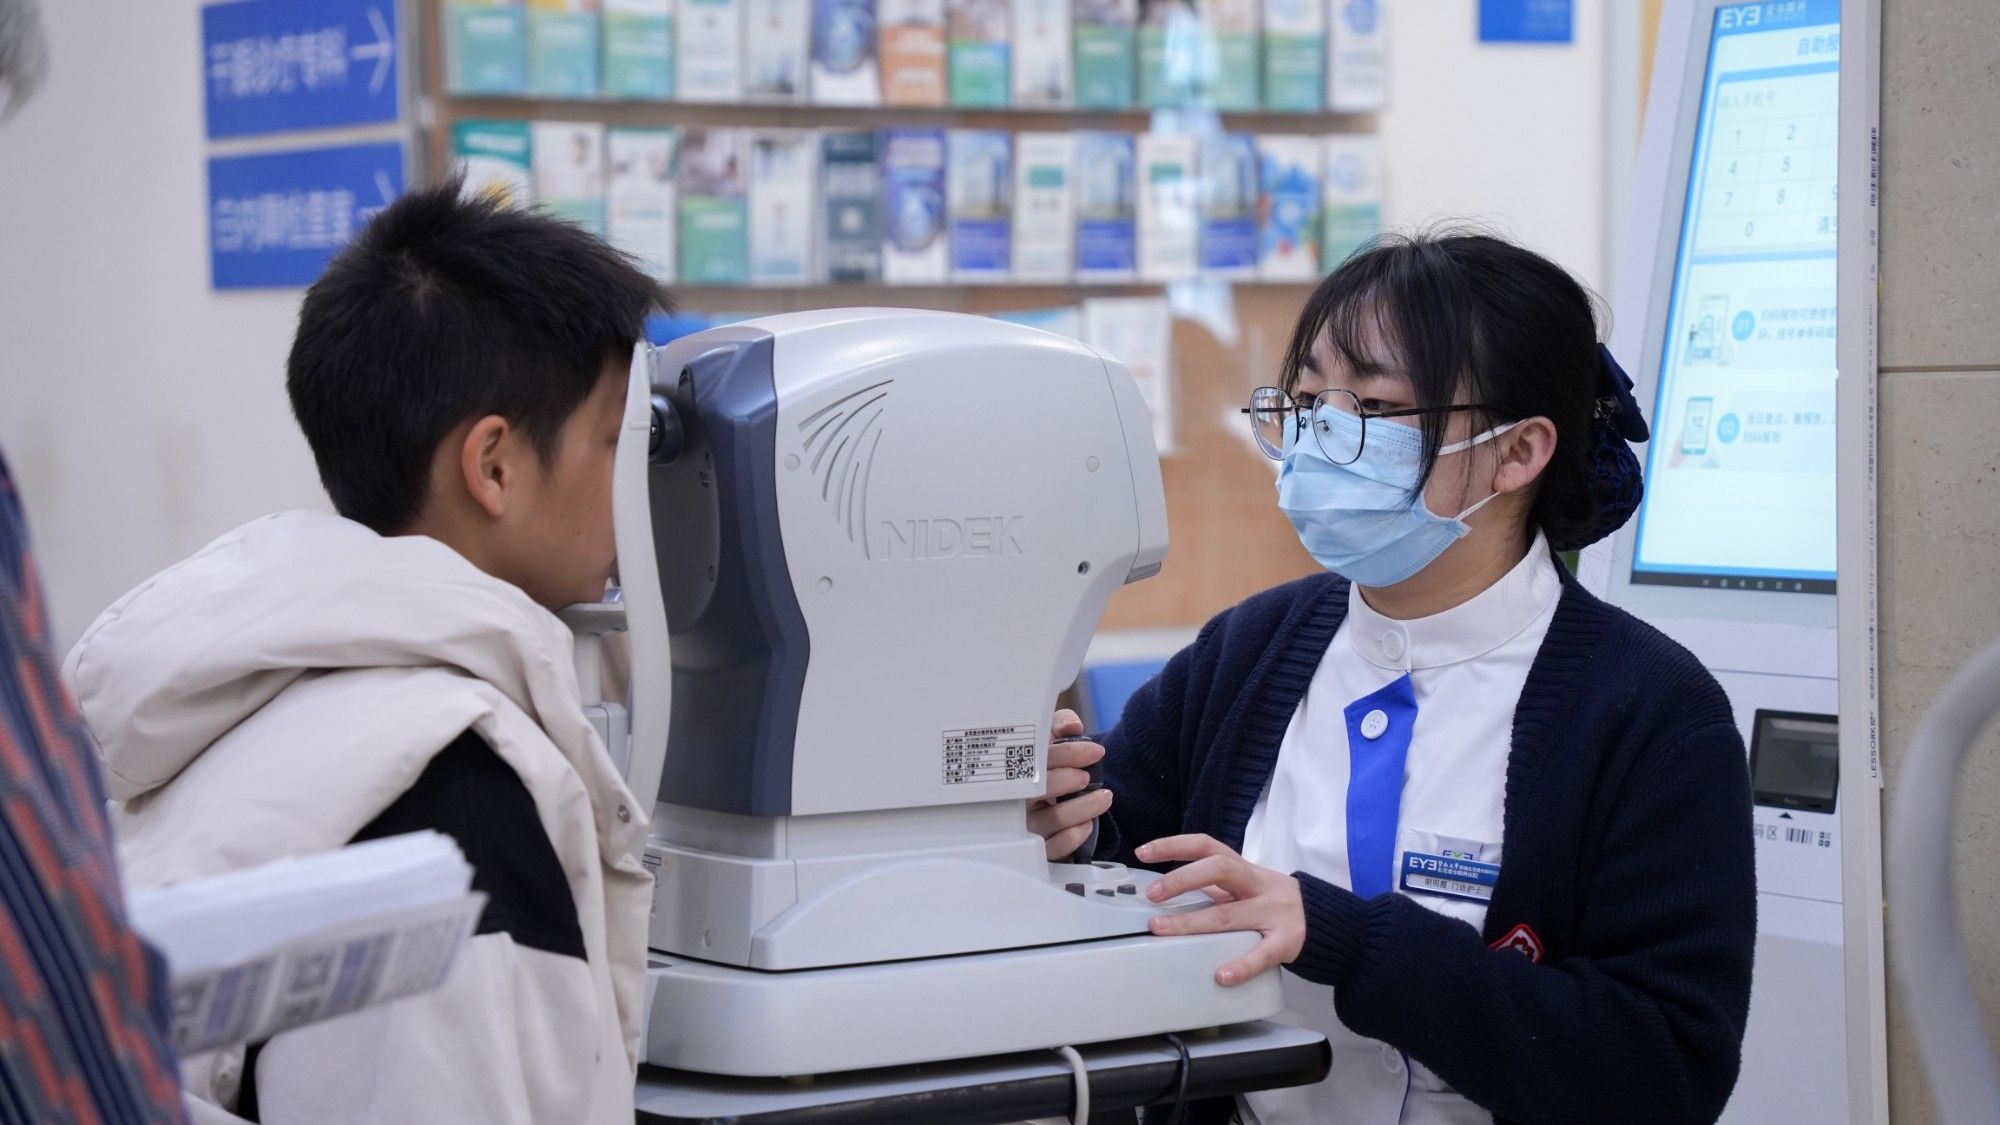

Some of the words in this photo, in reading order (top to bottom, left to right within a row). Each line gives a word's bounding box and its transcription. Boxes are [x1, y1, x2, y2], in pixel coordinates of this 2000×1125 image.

[1734, 128, 1742, 144] 1
[1786, 124, 1796, 141] 2
[1728, 159, 1738, 176] 4
[1781, 155, 1791, 173] 5
[1723, 191, 1734, 207] 7
[1776, 186, 1786, 204] 8
[1744, 221, 1754, 238] 0
[880, 515, 1024, 561] NIDEK
